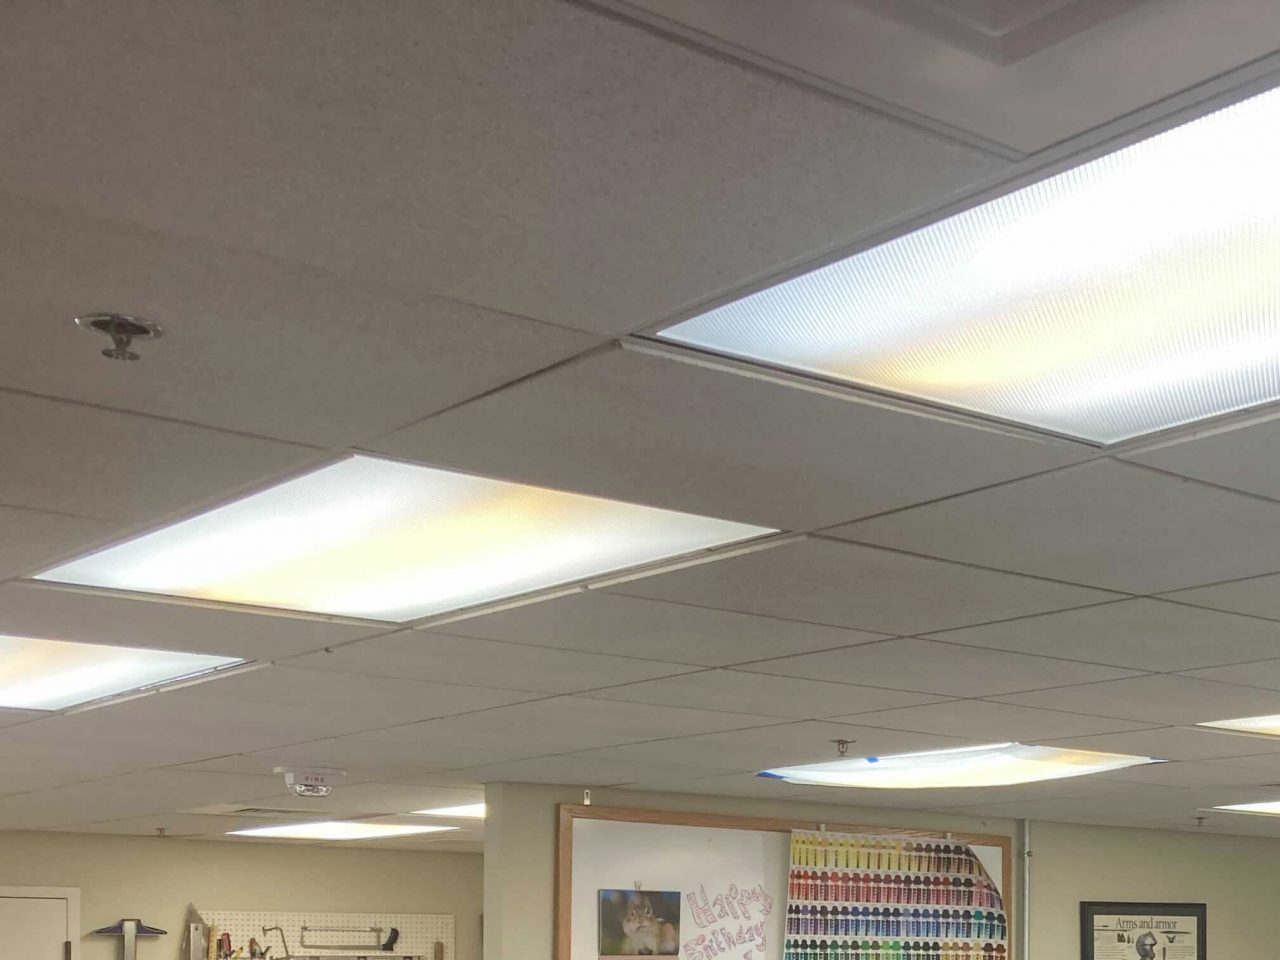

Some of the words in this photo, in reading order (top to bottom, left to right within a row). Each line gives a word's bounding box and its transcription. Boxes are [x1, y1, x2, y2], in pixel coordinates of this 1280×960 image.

[686, 884, 773, 928] Happy
[1115, 917, 1138, 929] Arms
[1138, 917, 1153, 929] and
[1154, 920, 1177, 929] armor
